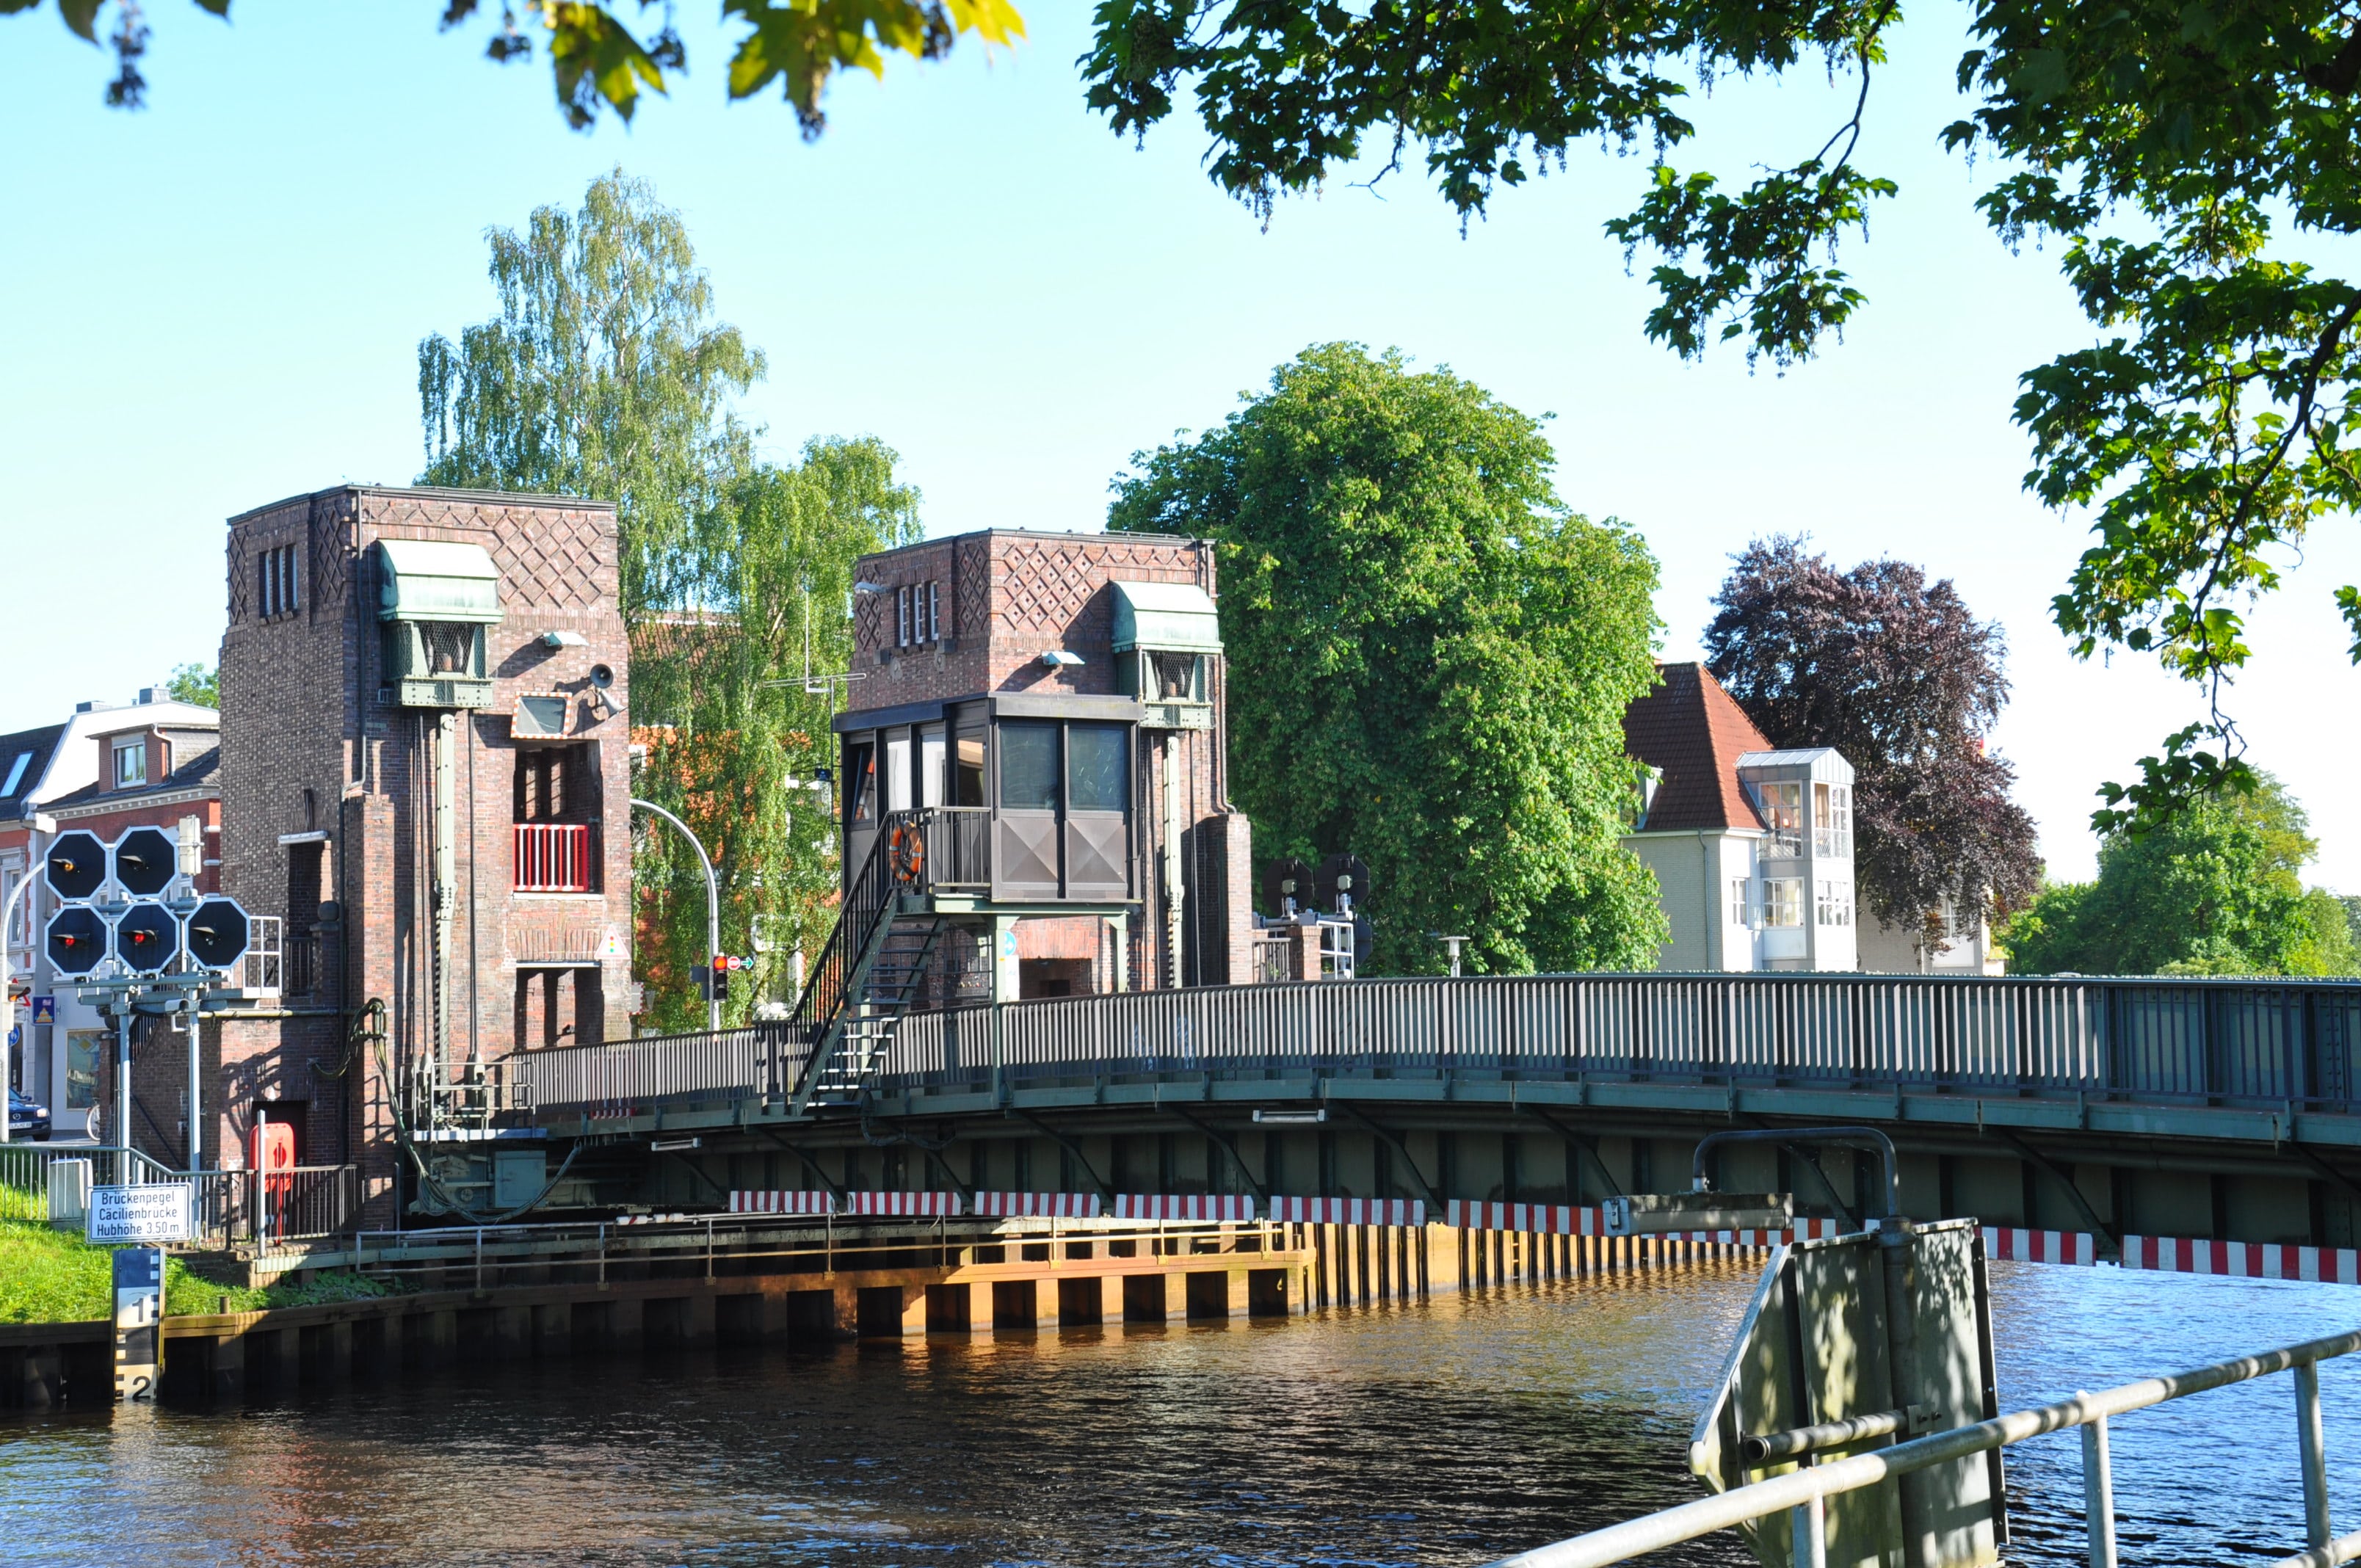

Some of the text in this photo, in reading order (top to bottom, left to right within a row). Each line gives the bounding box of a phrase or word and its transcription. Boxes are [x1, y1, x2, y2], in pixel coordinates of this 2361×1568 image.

[102, 1191, 175, 1205] Brückenpegel
[99, 1206, 178, 1221] Cäcilienbrücke
[97, 1222, 142, 1236] Hubhöhe
[170, 1224, 179, 1233] m
[132, 1297, 144, 1323] 1
[132, 1368, 151, 1401] 2
